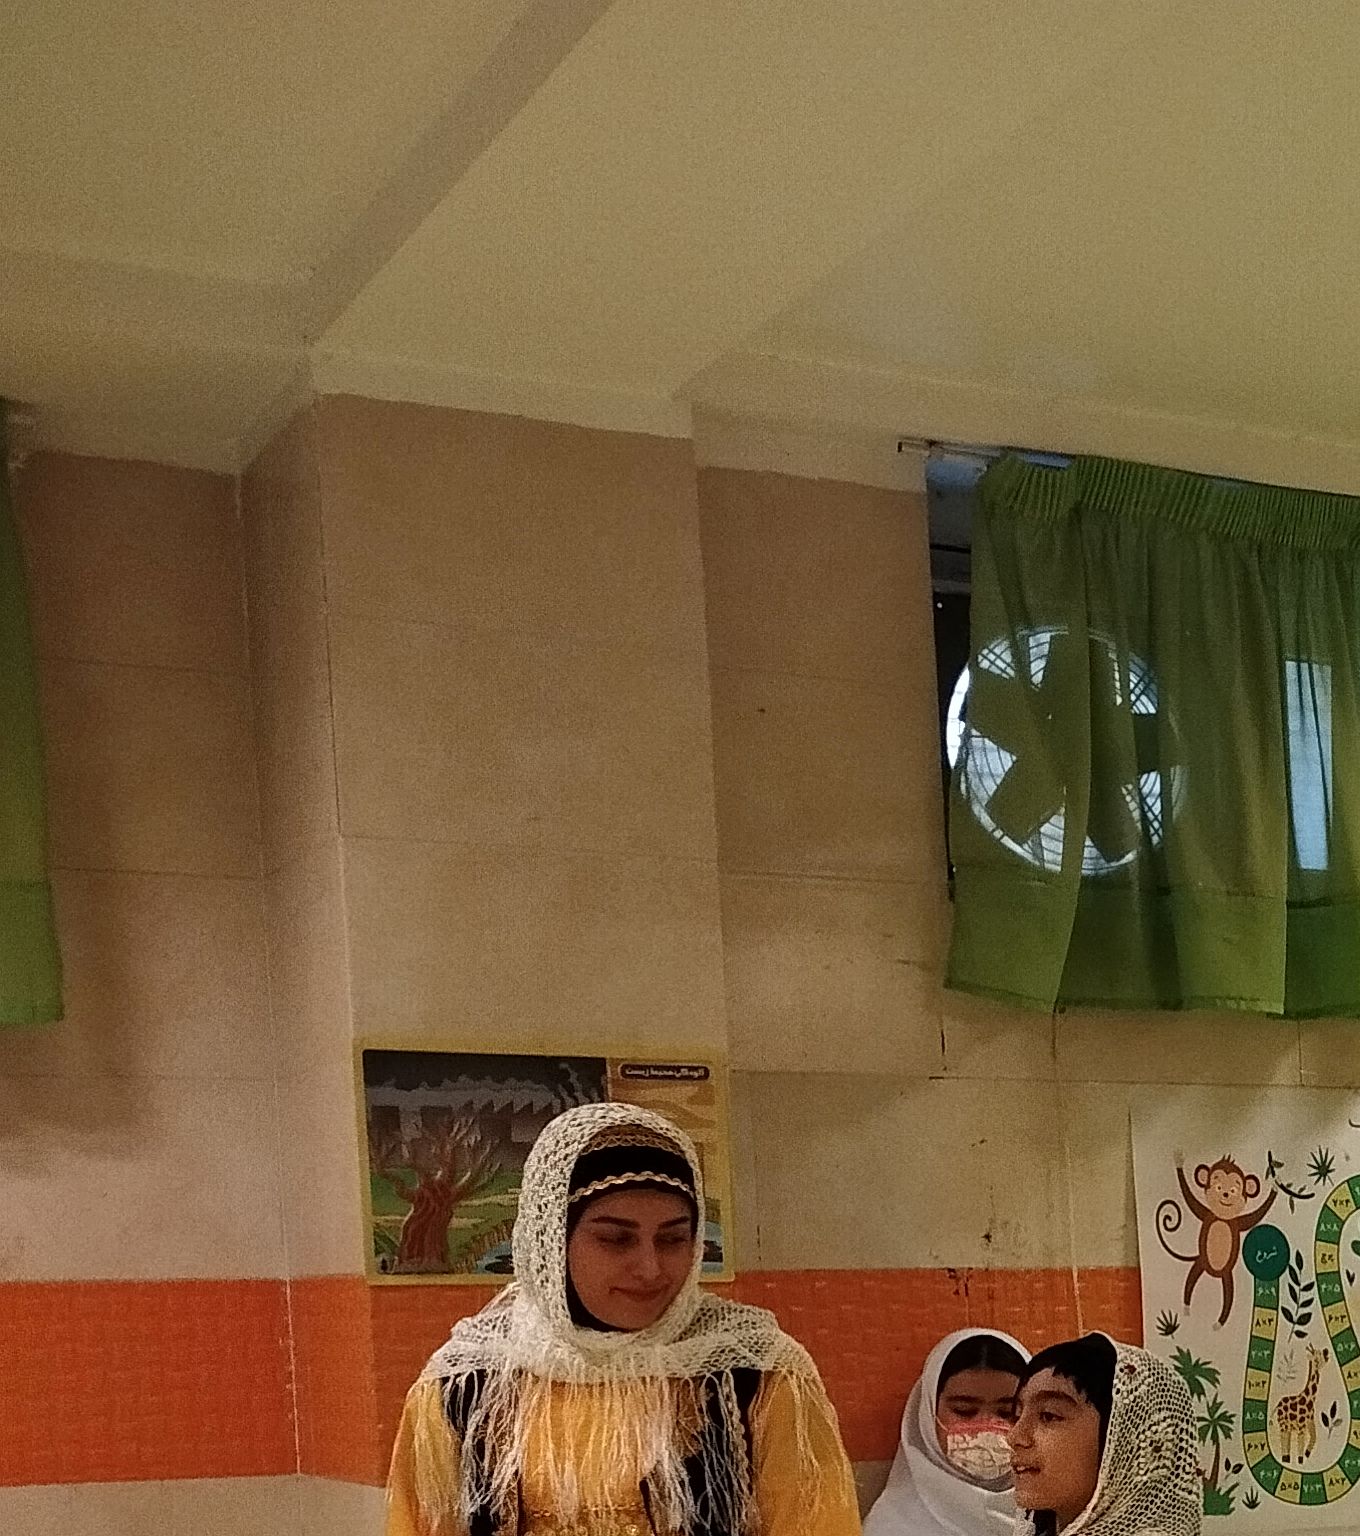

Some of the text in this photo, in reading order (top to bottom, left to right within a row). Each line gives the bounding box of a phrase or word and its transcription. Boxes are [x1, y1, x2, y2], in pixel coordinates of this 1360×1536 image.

[1320, 1223, 1339, 1231] ۸×۸
[1255, 1245, 1278, 1264] شروع
[1254, 1318, 1274, 1327] ۸×۳
[1280, 1483, 1300, 1491] ۵×۵
